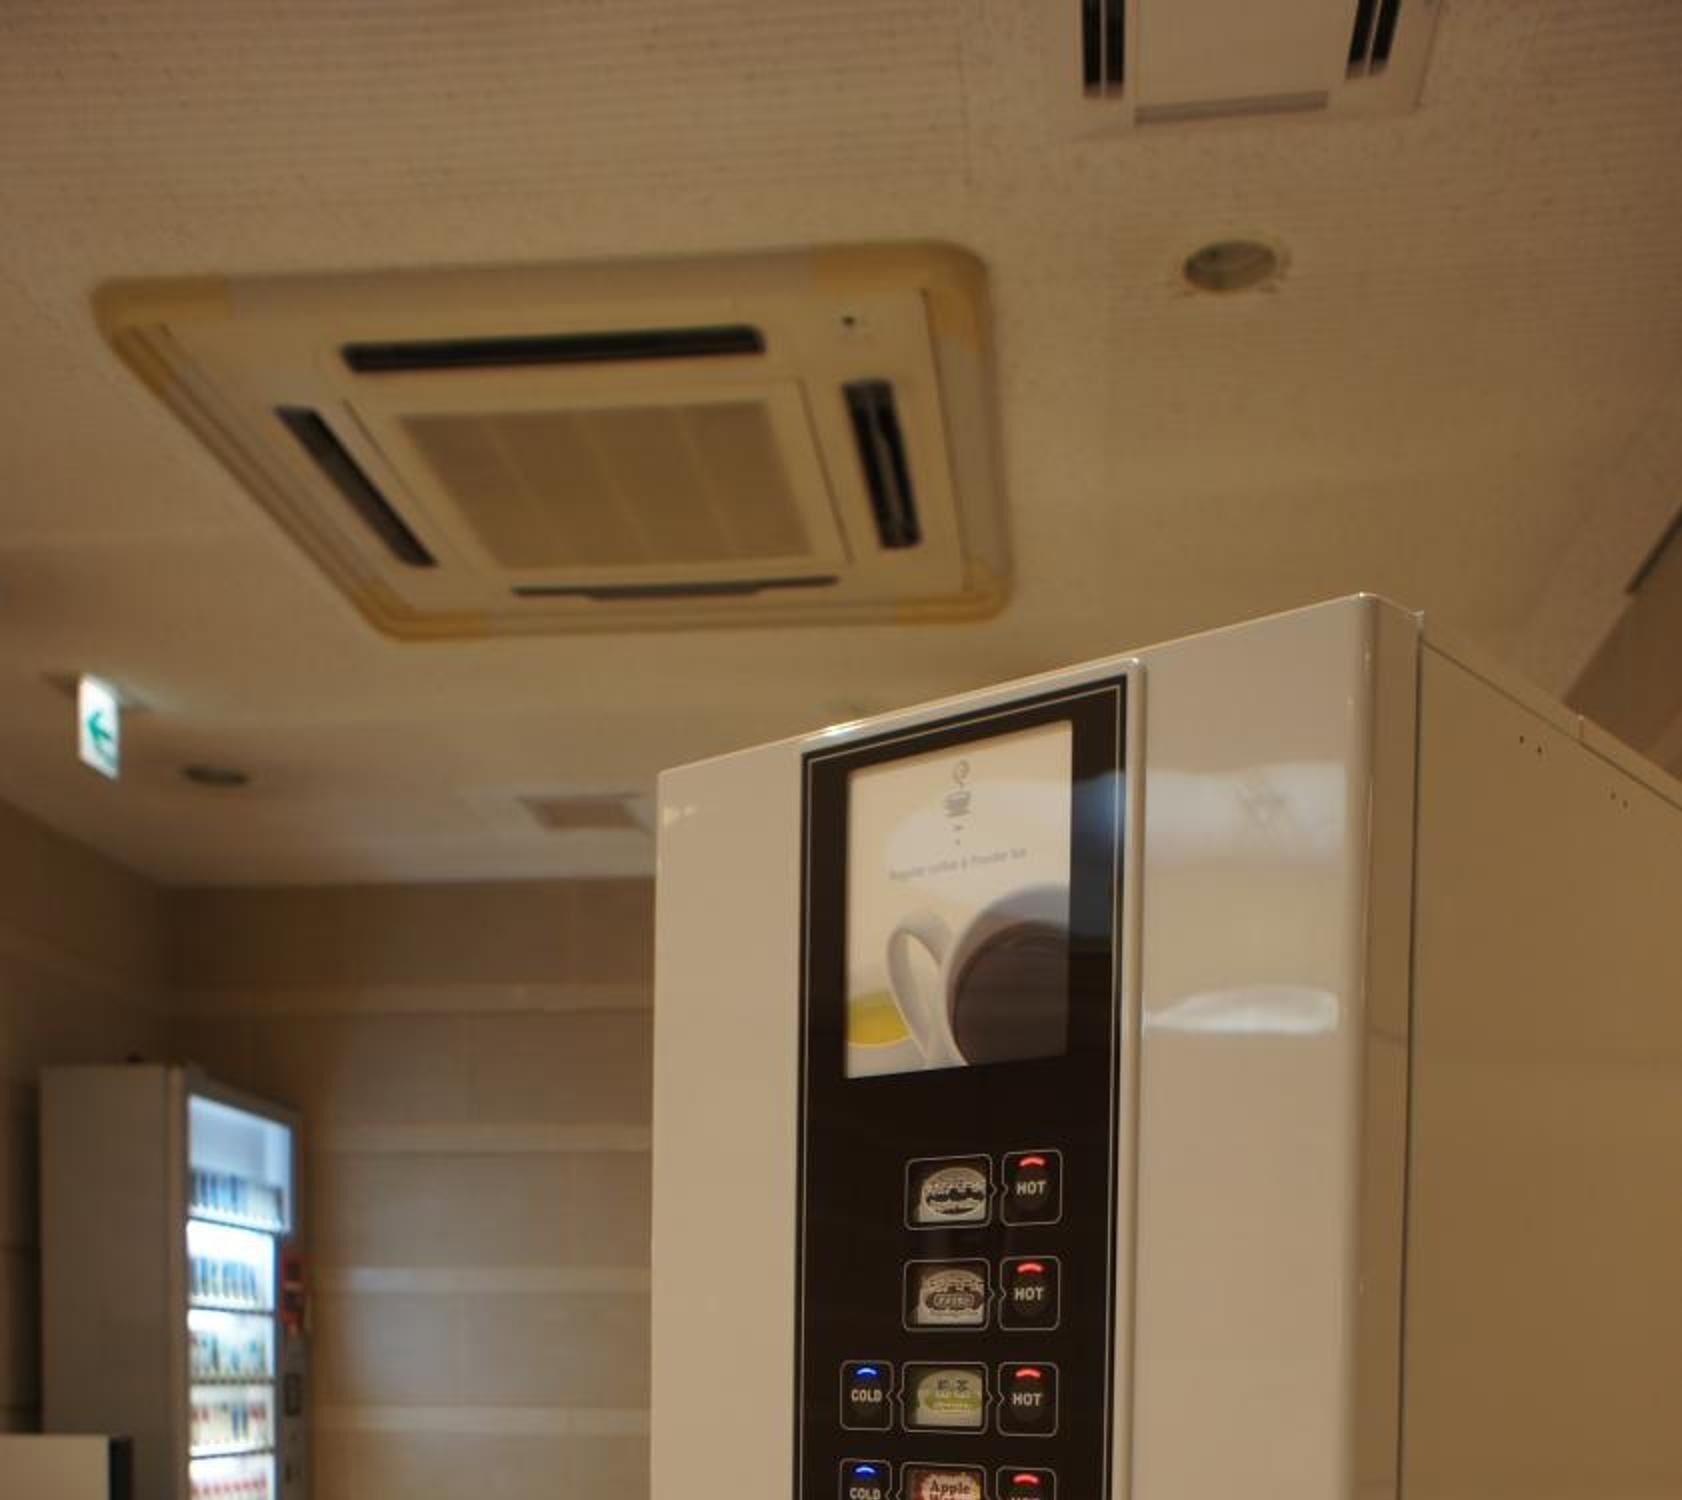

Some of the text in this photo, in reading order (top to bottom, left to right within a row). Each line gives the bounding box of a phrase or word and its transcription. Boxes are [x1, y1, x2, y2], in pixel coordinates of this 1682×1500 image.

[1016, 1181, 1047, 1195] HOT
[1014, 1287, 1044, 1301] HOT
[851, 1389, 882, 1402] COLD
[1012, 1392, 1042, 1406] HOT
[849, 1487, 881, 1500] COLD
[930, 1479, 971, 1497] Apple
